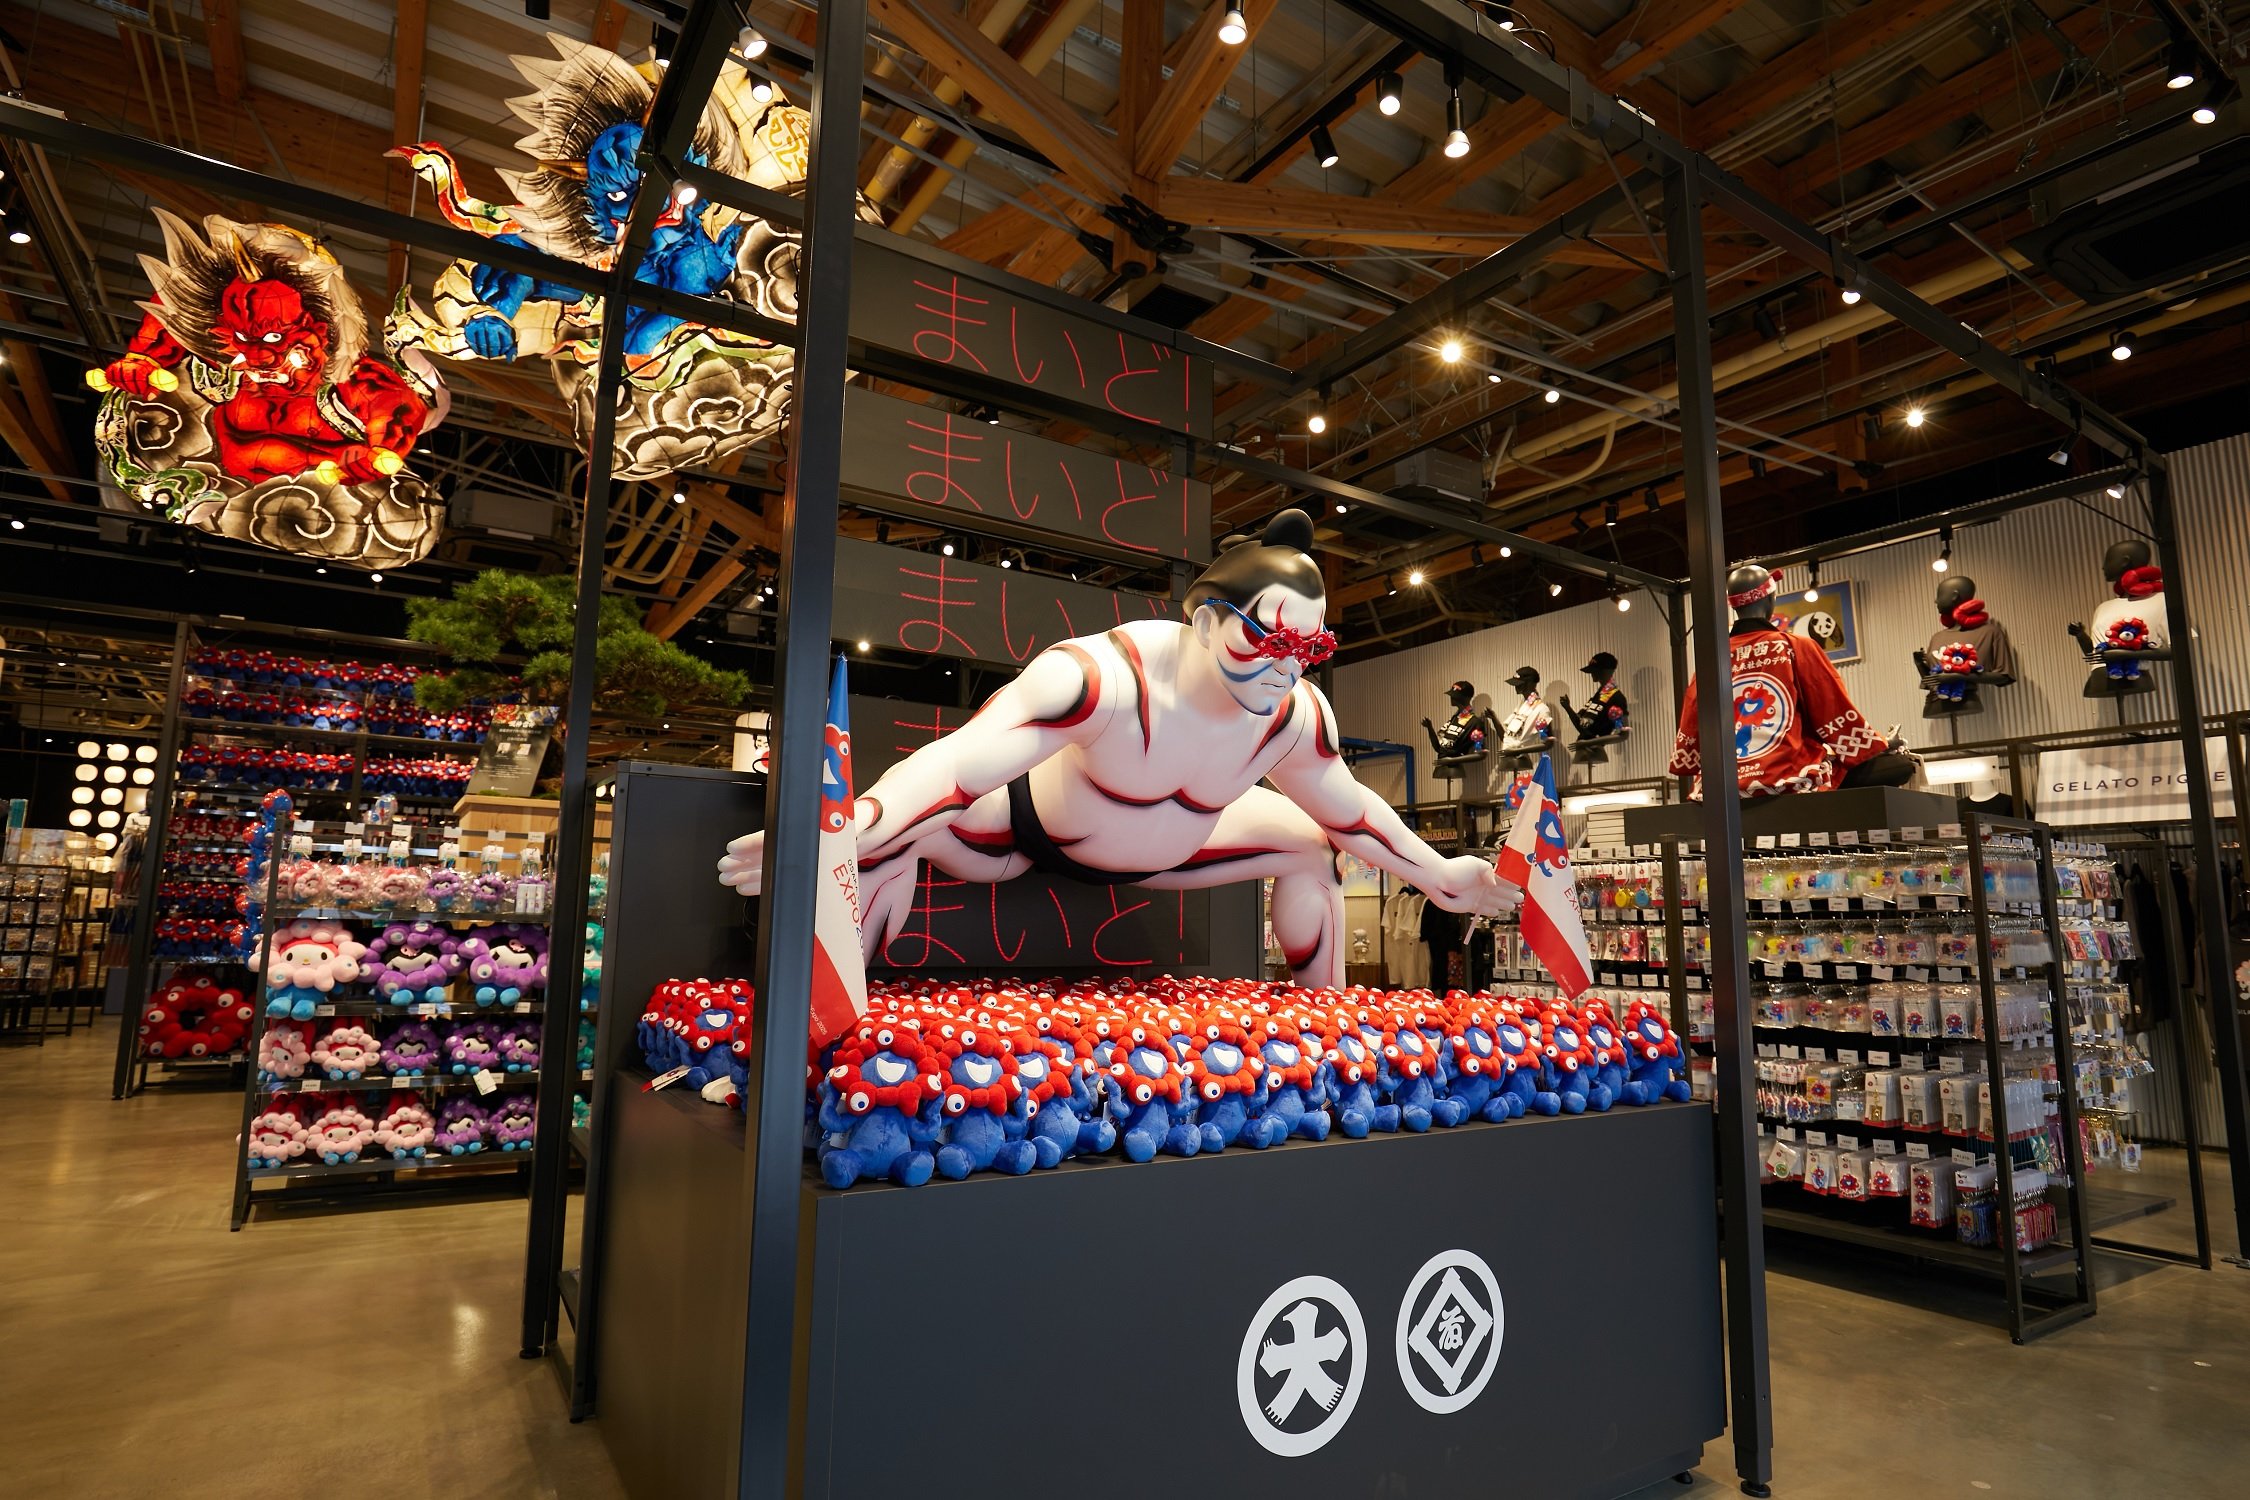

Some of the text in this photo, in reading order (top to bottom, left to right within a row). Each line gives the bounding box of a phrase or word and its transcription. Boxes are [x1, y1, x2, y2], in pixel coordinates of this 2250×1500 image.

[1816, 710, 1858, 739] EXPO
[2053, 770, 2226, 793] GELATO PIQE
[832, 863, 860, 923] EXPO
